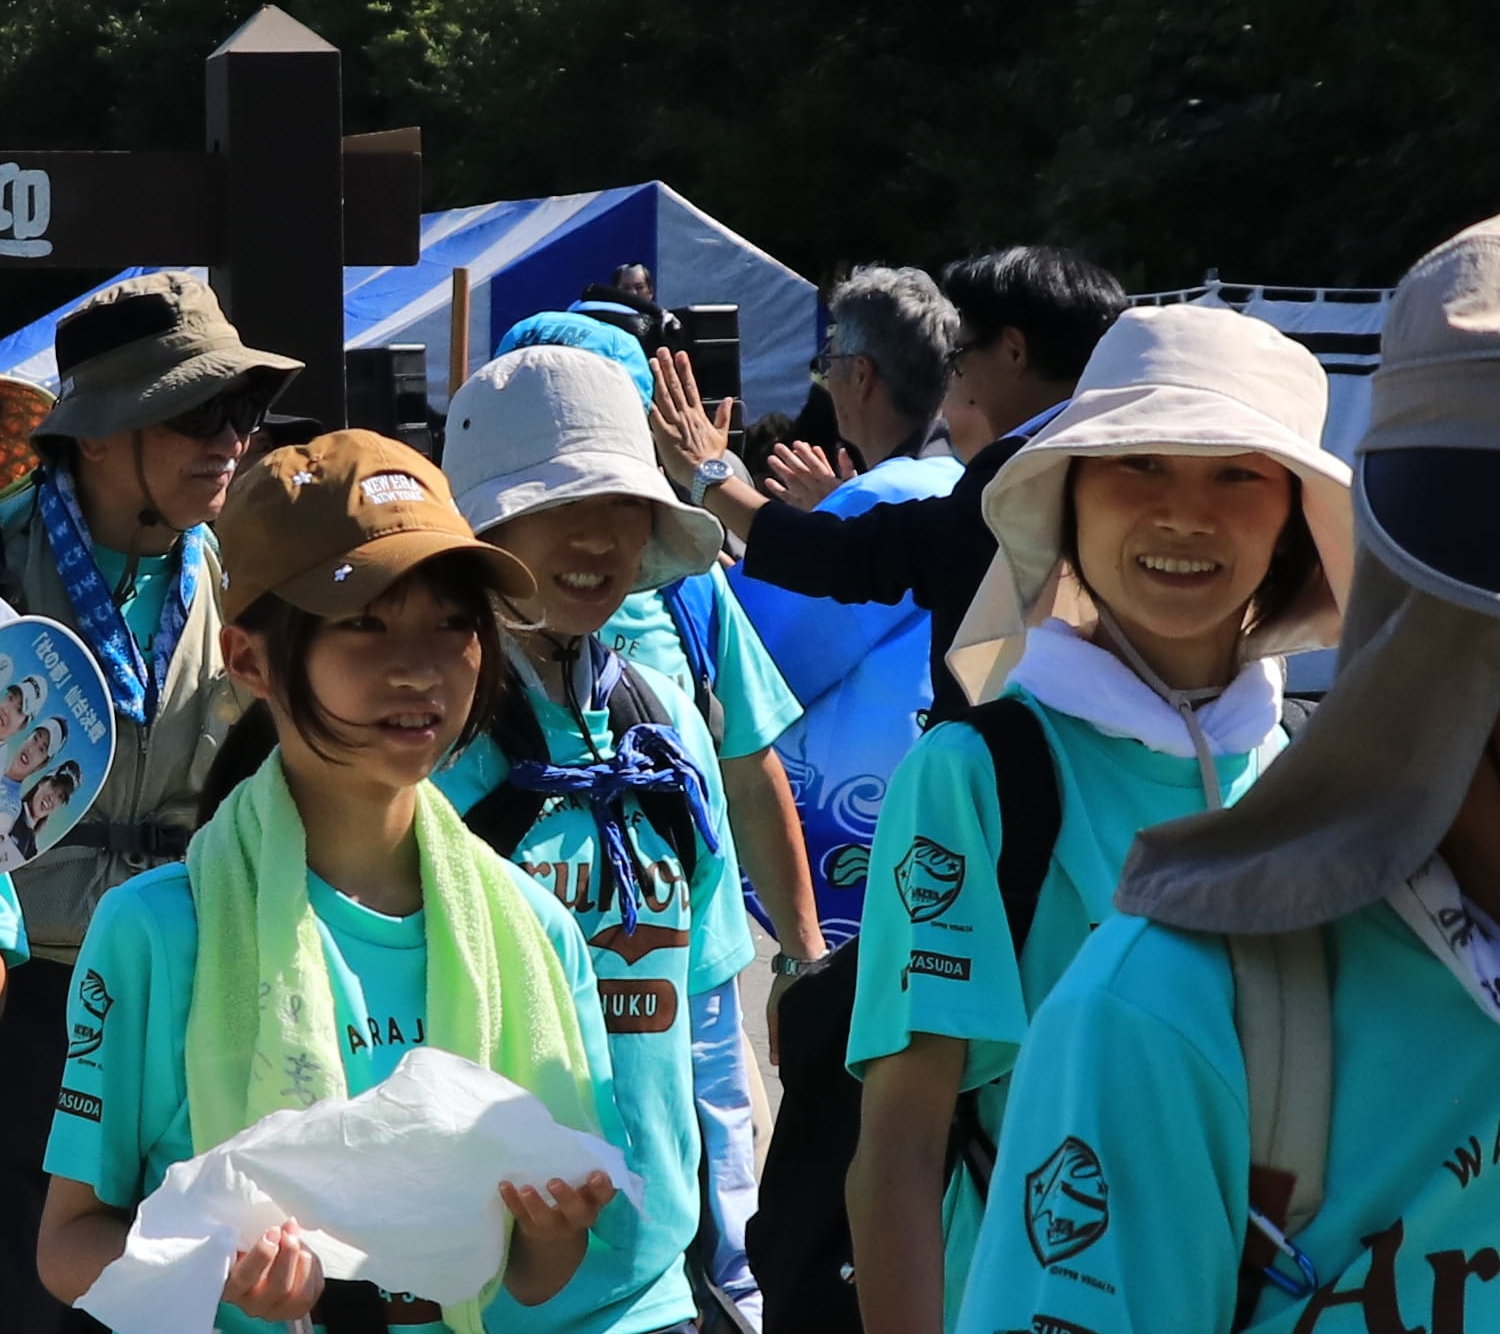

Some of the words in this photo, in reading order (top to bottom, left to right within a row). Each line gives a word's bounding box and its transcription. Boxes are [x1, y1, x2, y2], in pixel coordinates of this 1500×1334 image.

[360, 475, 390, 497] NEW
[389, 473, 424, 492] ERA
[612, 633, 641, 659] DE
